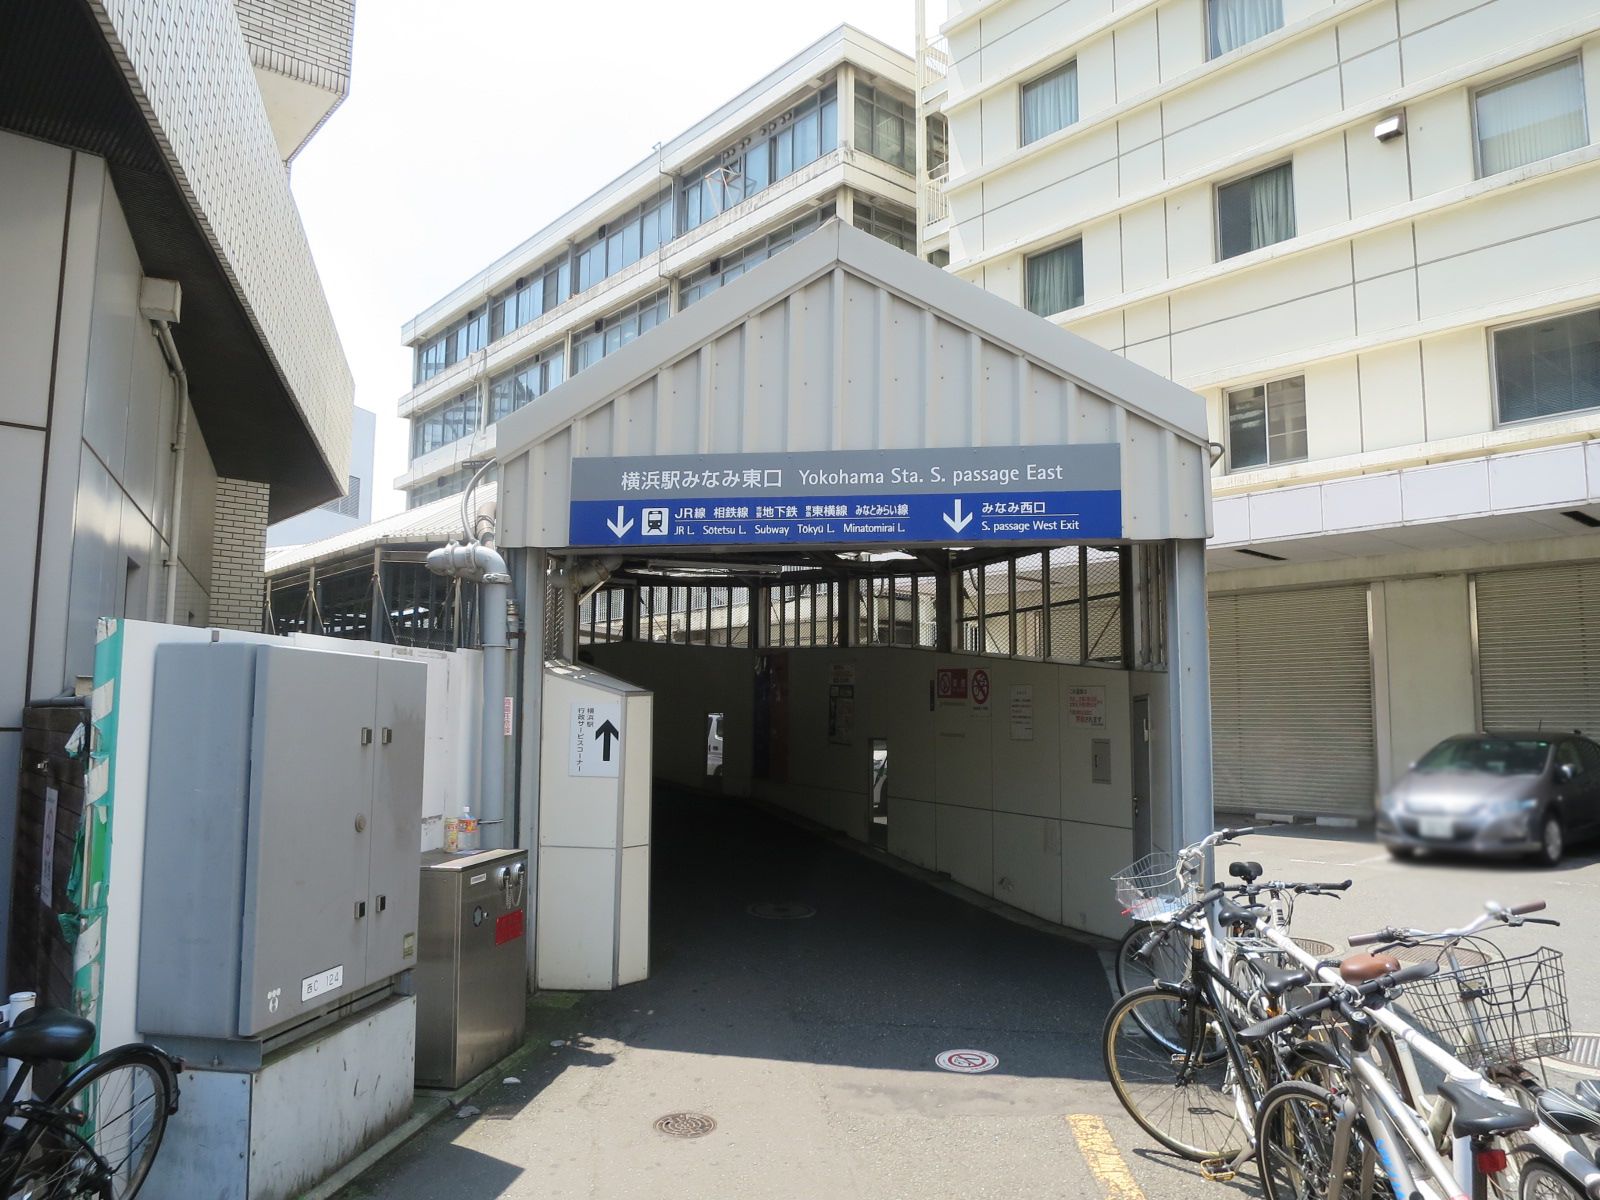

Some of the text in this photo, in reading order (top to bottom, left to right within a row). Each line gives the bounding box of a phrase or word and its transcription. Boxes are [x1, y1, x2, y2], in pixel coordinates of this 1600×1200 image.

[621, 469, 782, 491] 横浜駅みなみ東口
[799, 463, 1064, 486] Yokohama Sta. S. passage East
[674, 507, 706, 519] JR線
[713, 506, 749, 519] 相鉄線
[855, 503, 909, 516] みなとみらい線
[981, 501, 1046, 514] みなみ西口
[673, 525, 685, 536] JR
[738, 525, 747, 535] L.
[754, 524, 790, 536] Subway
[826, 523, 835, 533] L.
[843, 522, 895, 533] Minatomirai
[897, 522, 906, 533] L.
[981, 519, 1080, 533] S. passage West Exit
[576, 707, 585, 772] 行政サービスコーナー
[326, 971, 339, 987] 124
